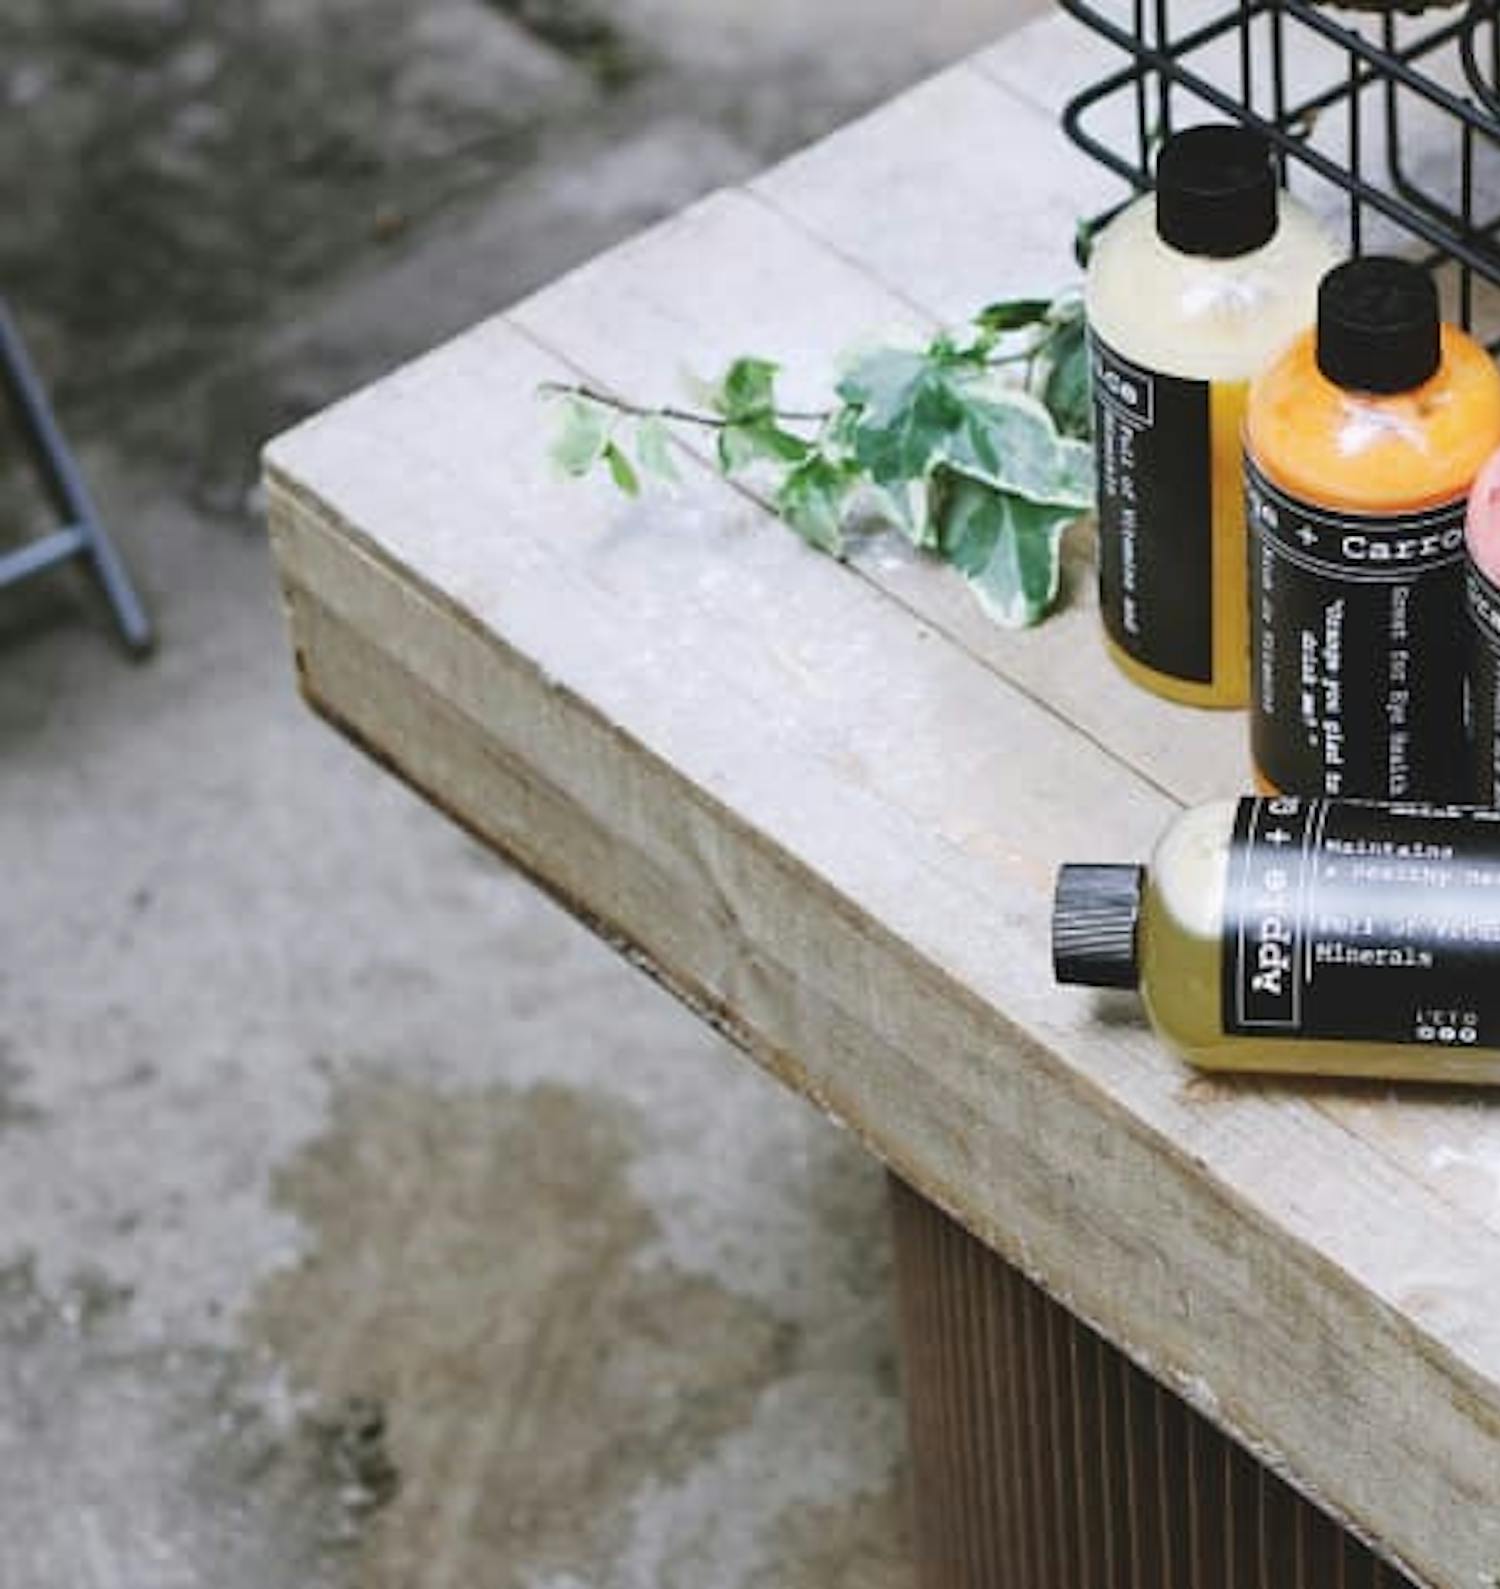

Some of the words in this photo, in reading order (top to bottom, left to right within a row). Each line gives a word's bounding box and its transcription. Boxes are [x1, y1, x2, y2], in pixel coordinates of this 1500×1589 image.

[1342, 527, 1464, 562] Carro
[1267, 796, 1300, 817] G
[1324, 837, 1456, 861] Maintains
[1252, 868, 1296, 996] Apple
[1314, 940, 1435, 970] Minerals
